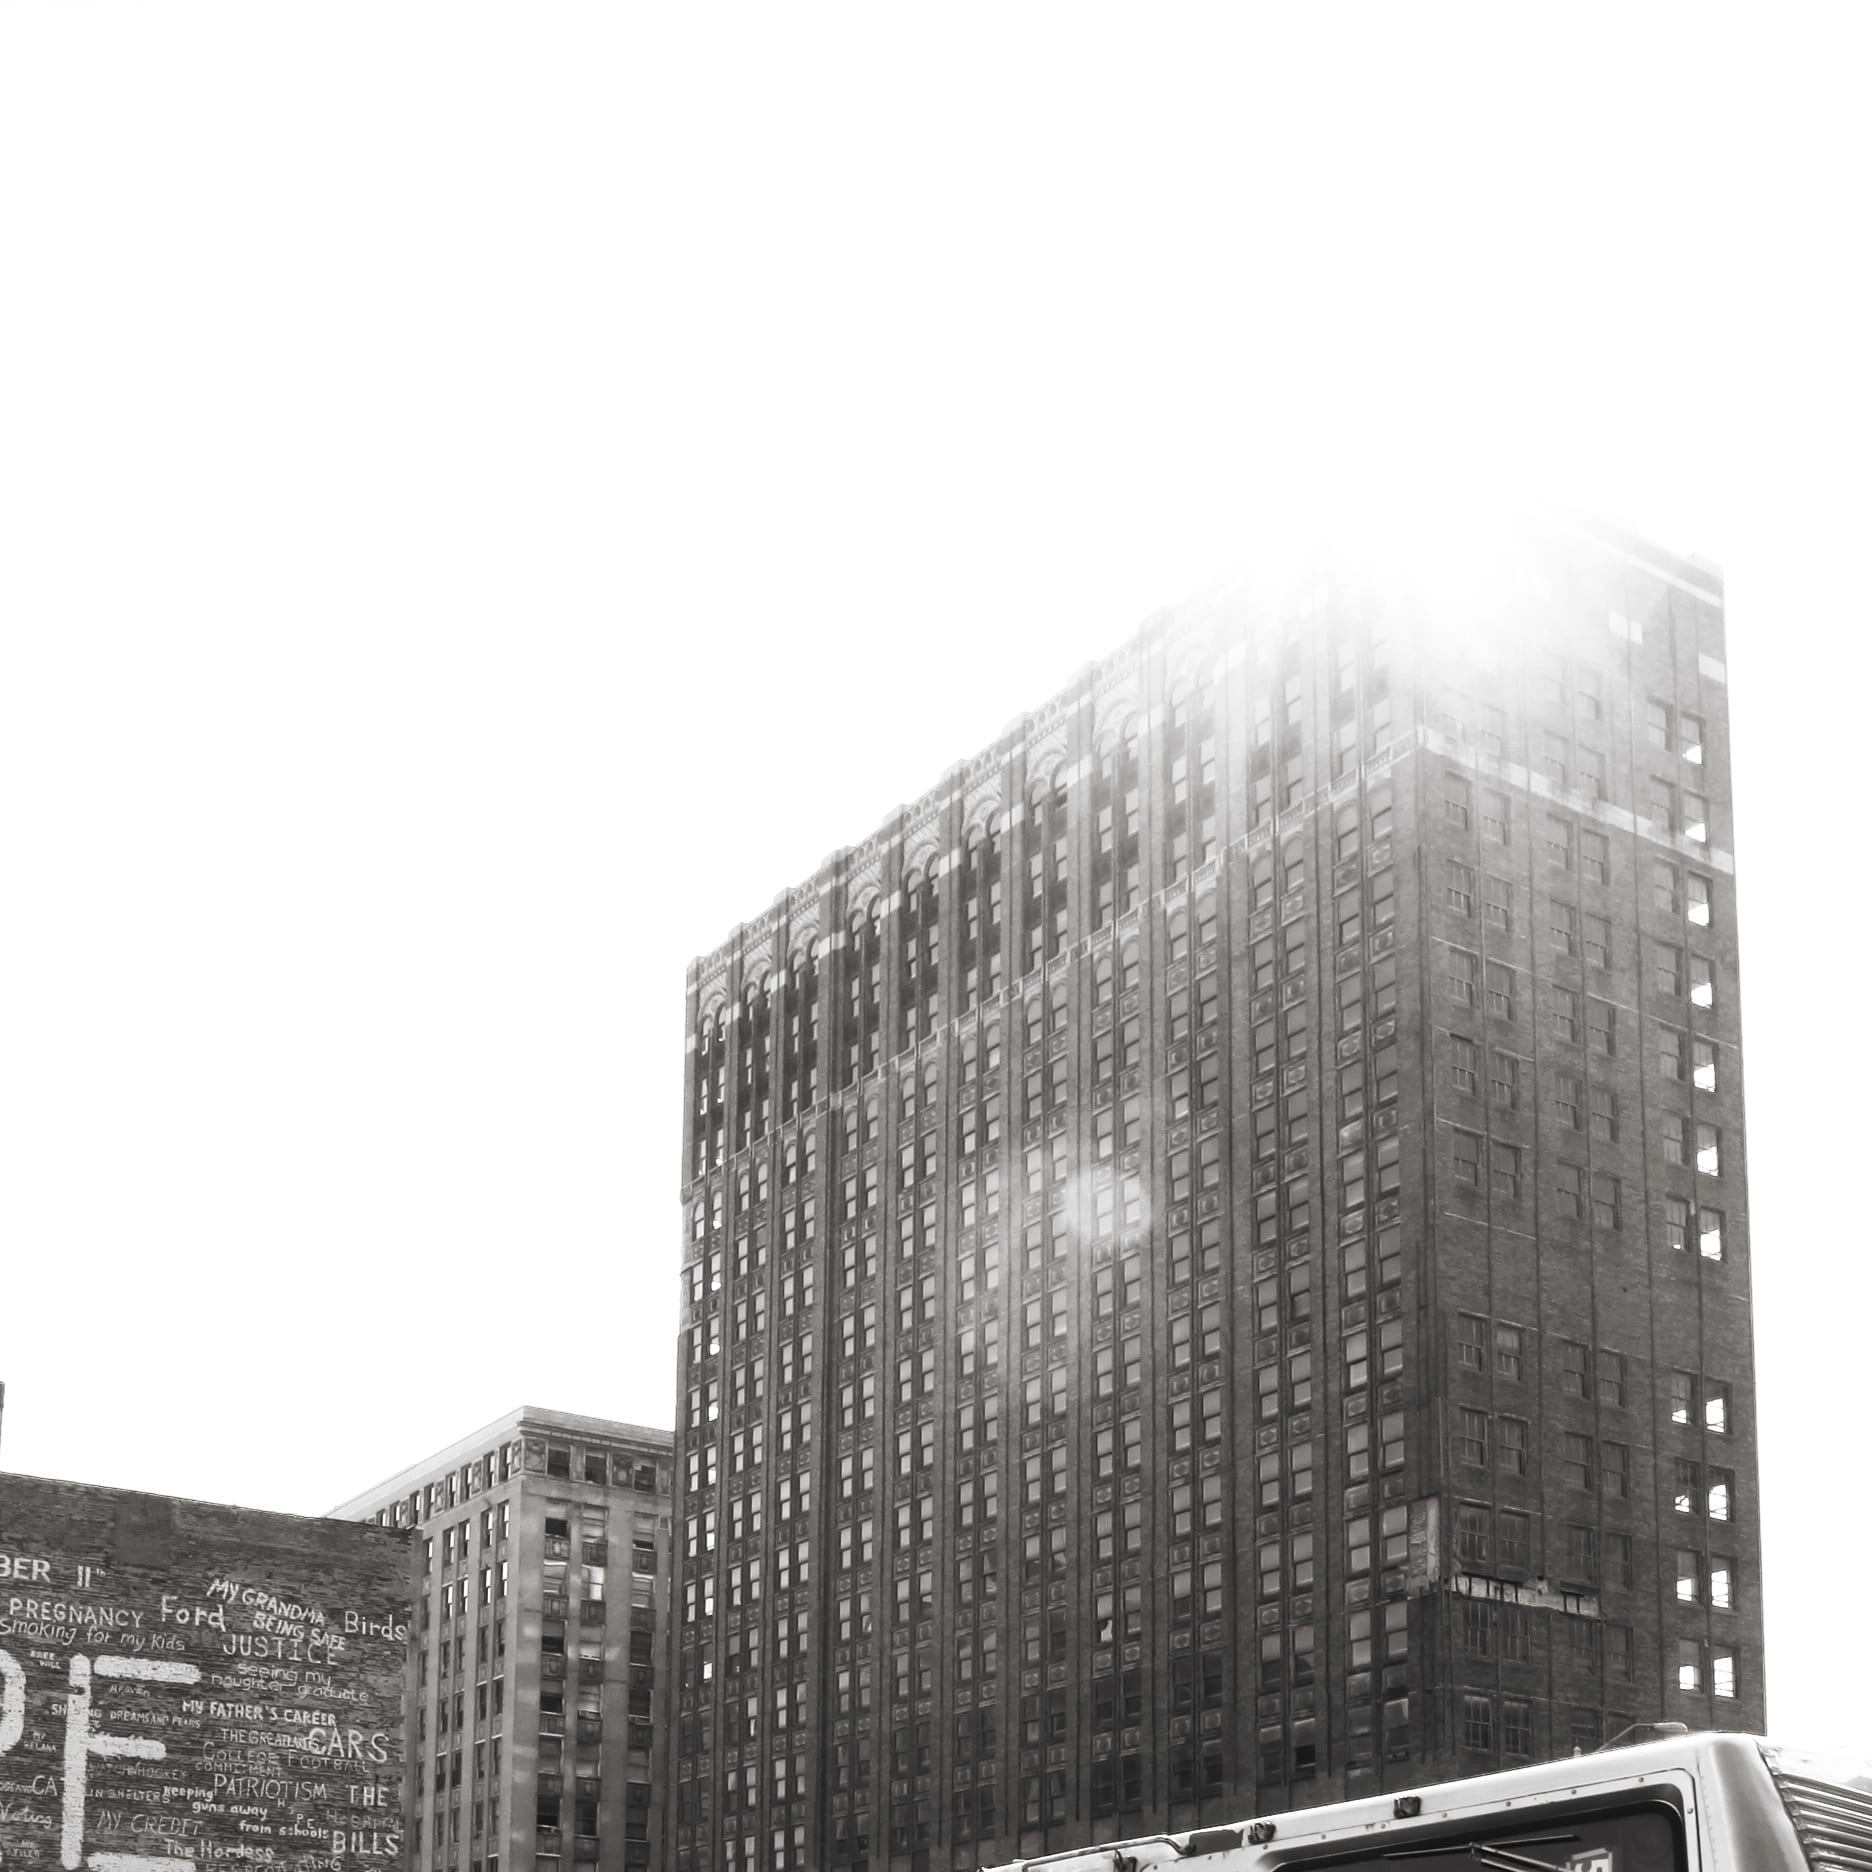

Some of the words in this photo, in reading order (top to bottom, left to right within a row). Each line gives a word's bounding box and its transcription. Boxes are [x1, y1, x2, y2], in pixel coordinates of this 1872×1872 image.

[8, 1597, 145, 1630] PREGNANCY
[161, 1594, 227, 1634] Ford
[206, 1578, 241, 1604] MY
[241, 1587, 327, 1629] GRANDMA
[85, 1626, 113, 1645] for
[120, 1633, 146, 1652] my
[252, 1612, 306, 1640] BEING
[343, 1609, 409, 1643] Birds
[236, 1662, 298, 1683] seeing
[304, 1670, 332, 1689] my
[182, 1700, 204, 1714] MY
[284, 1708, 337, 1727] CAREER
[308, 1727, 390, 1764] CARS
[162, 1784, 215, 1806] keeping
[213, 1773, 328, 1801] PATRIOTISM
[347, 1784, 390, 1808] THE
[96, 1810, 122, 1832] MY
[130, 1813, 206, 1837] CREDIT
[191, 1800, 226, 1815] guns
[230, 1803, 268, 1821] away
[238, 1819, 272, 1836] from
[164, 1839, 196, 1859] The
[332, 1830, 401, 1857] BILLS
